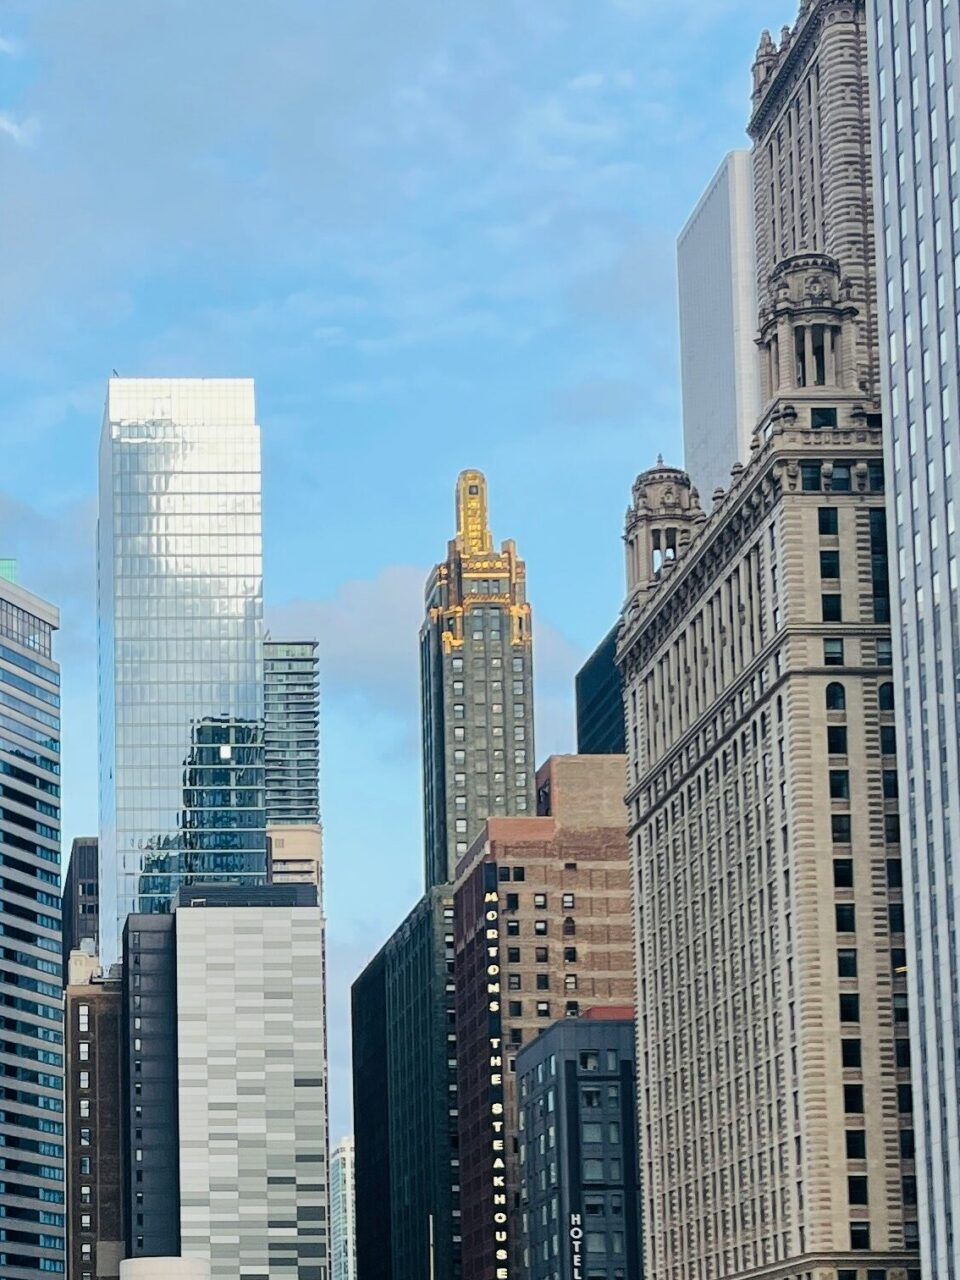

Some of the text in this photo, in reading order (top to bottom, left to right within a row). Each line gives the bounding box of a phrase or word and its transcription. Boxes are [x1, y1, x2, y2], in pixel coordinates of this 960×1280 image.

[490, 1038, 502, 1085] THE
[491, 1103, 508, 1280] STEAKHOUSE
[570, 1213, 583, 1280] HOTEL
